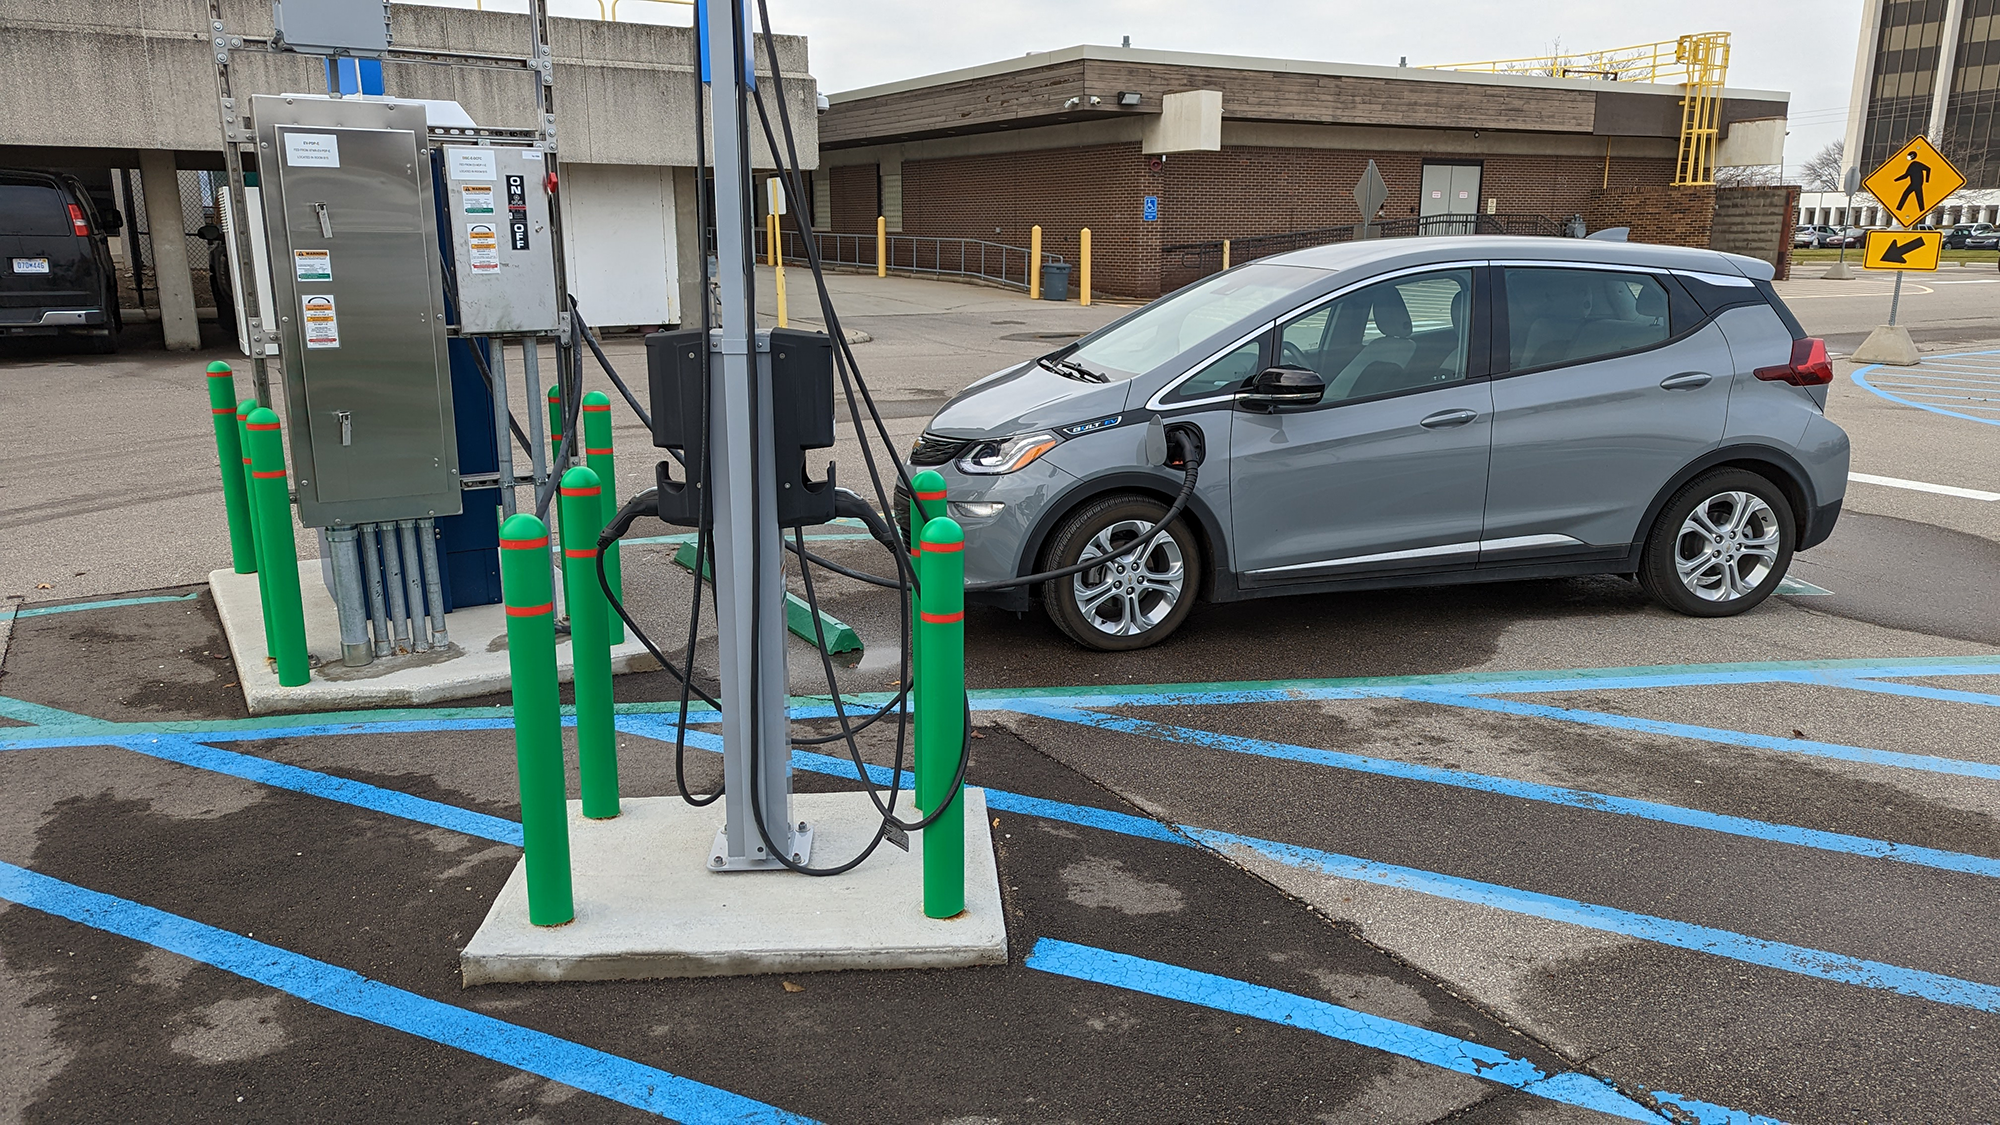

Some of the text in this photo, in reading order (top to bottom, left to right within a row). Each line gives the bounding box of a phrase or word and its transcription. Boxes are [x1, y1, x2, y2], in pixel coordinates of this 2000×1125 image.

[510, 176, 521, 195] ON
[514, 223, 524, 249] OFF
[1072, 418, 1118, 433] BOLT EV
